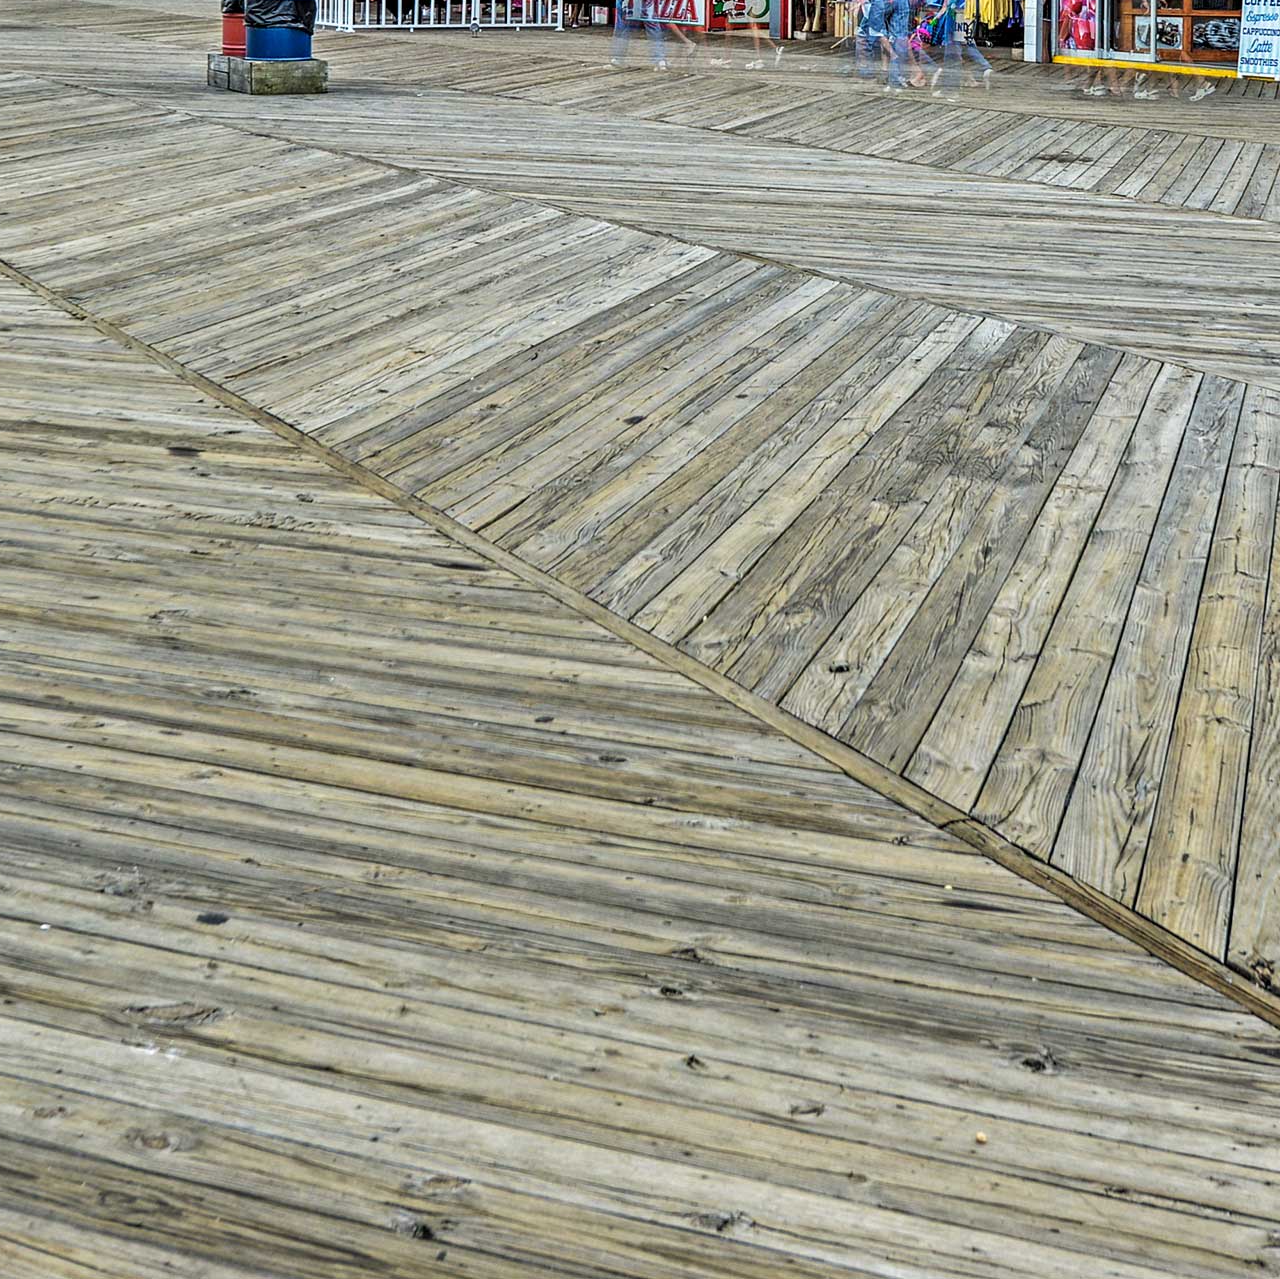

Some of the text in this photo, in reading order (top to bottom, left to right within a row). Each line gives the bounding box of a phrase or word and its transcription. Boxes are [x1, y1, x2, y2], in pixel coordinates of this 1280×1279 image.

[1245, 10, 1279, 25] Espresso
[1242, 27, 1280, 37] CAPPUCCINO
[1246, 38, 1273, 53] Latte
[1240, 56, 1279, 68] SMOOTHIES
